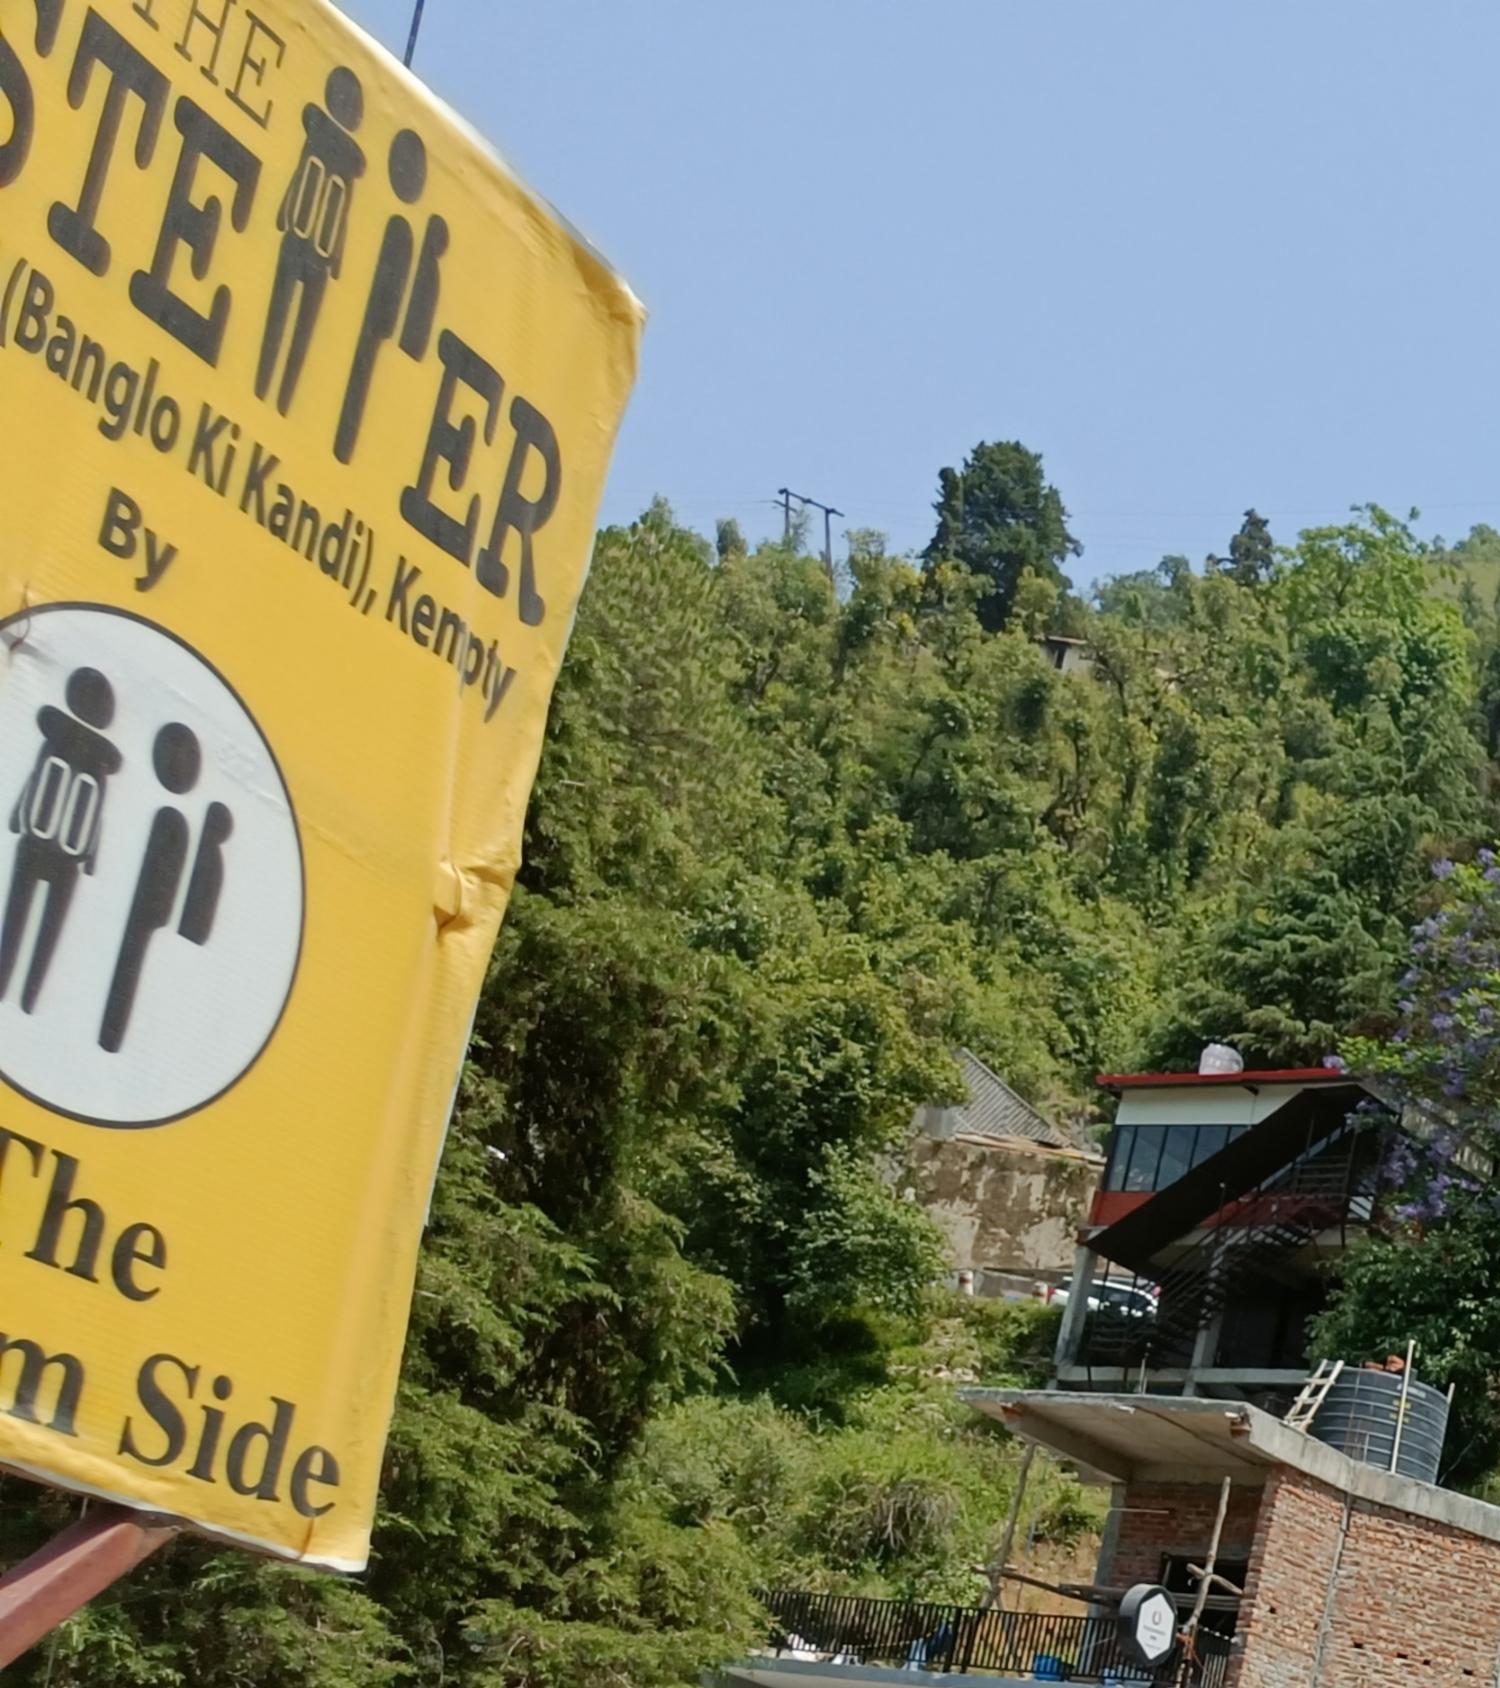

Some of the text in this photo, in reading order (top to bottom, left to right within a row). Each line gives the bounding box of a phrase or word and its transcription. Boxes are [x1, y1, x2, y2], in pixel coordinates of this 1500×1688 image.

[132, 0, 286, 130] HE
[97, 486, 179, 593] By
[186, 402, 241, 497] Ki
[385, 555, 518, 724] Kempty
[117, 1352, 341, 1519] Side
